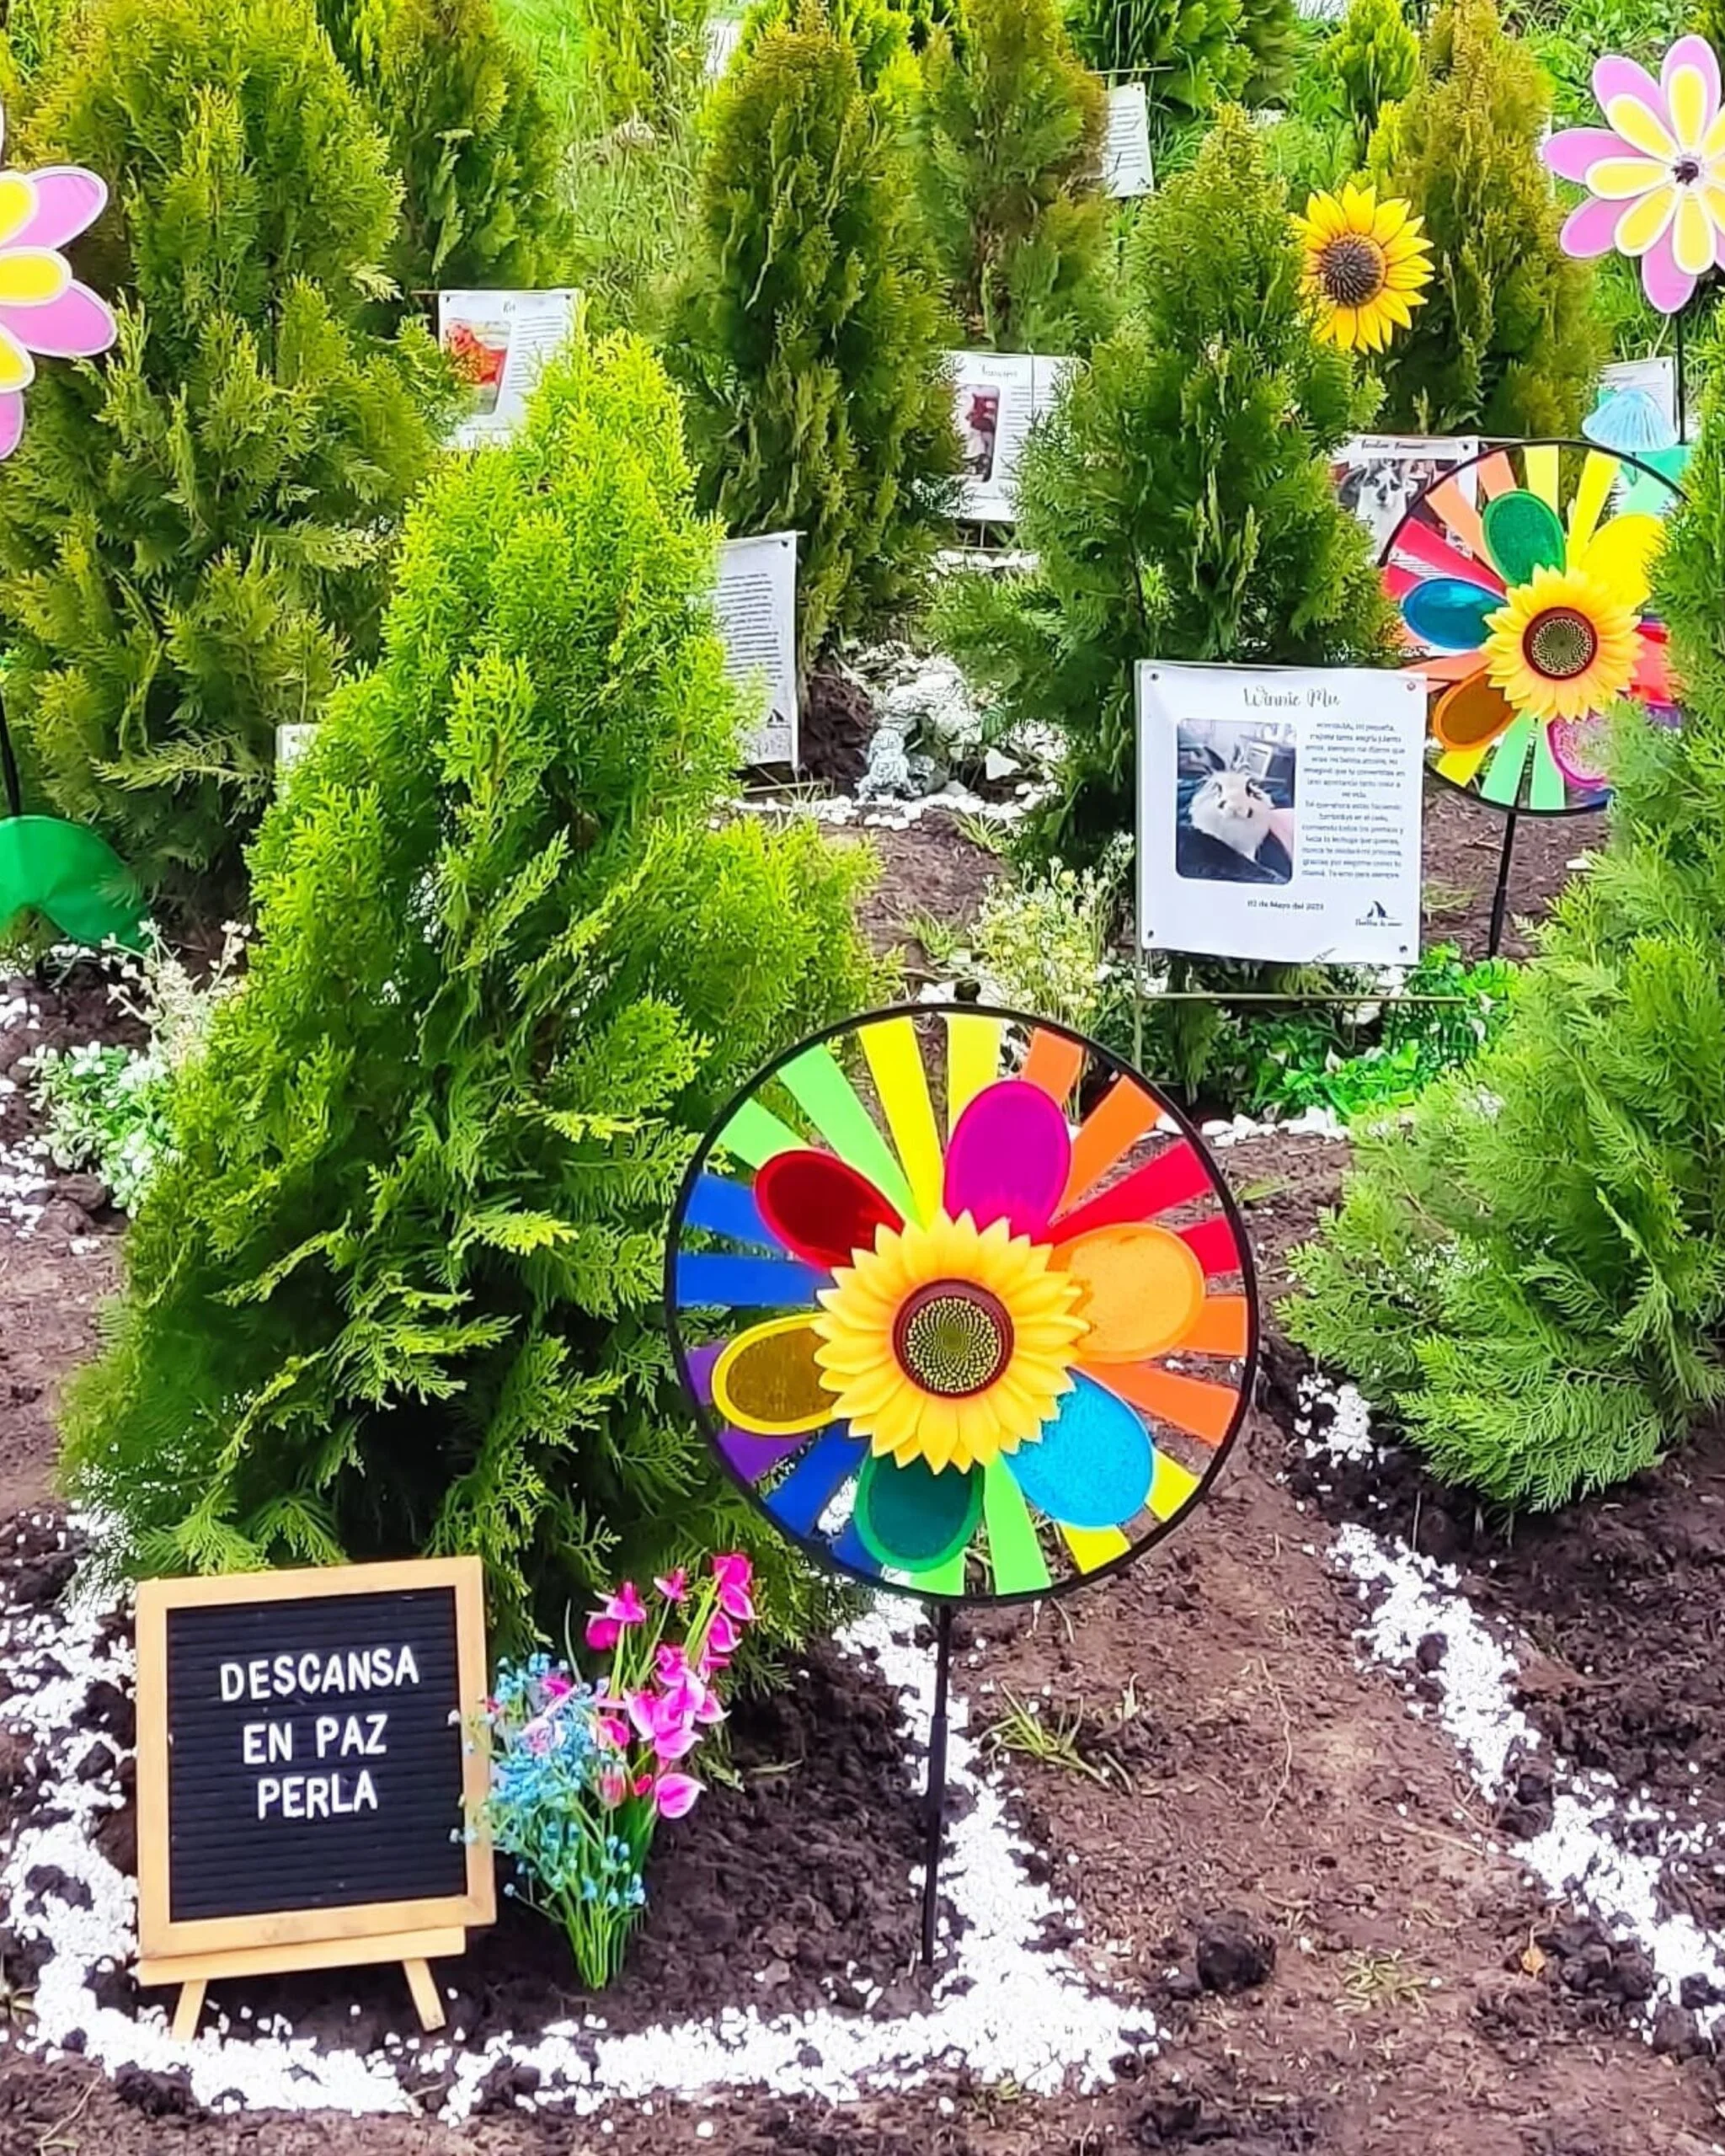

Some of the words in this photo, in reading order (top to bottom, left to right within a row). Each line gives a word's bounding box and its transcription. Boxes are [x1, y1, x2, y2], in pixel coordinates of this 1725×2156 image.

[1243, 685, 1300, 707] Winnie
[220, 1645, 419, 1701] DESCANSA
[243, 1722, 292, 1764] EN
[315, 1714, 388, 1758] PAZ
[258, 1769, 378, 1820] PERLA
